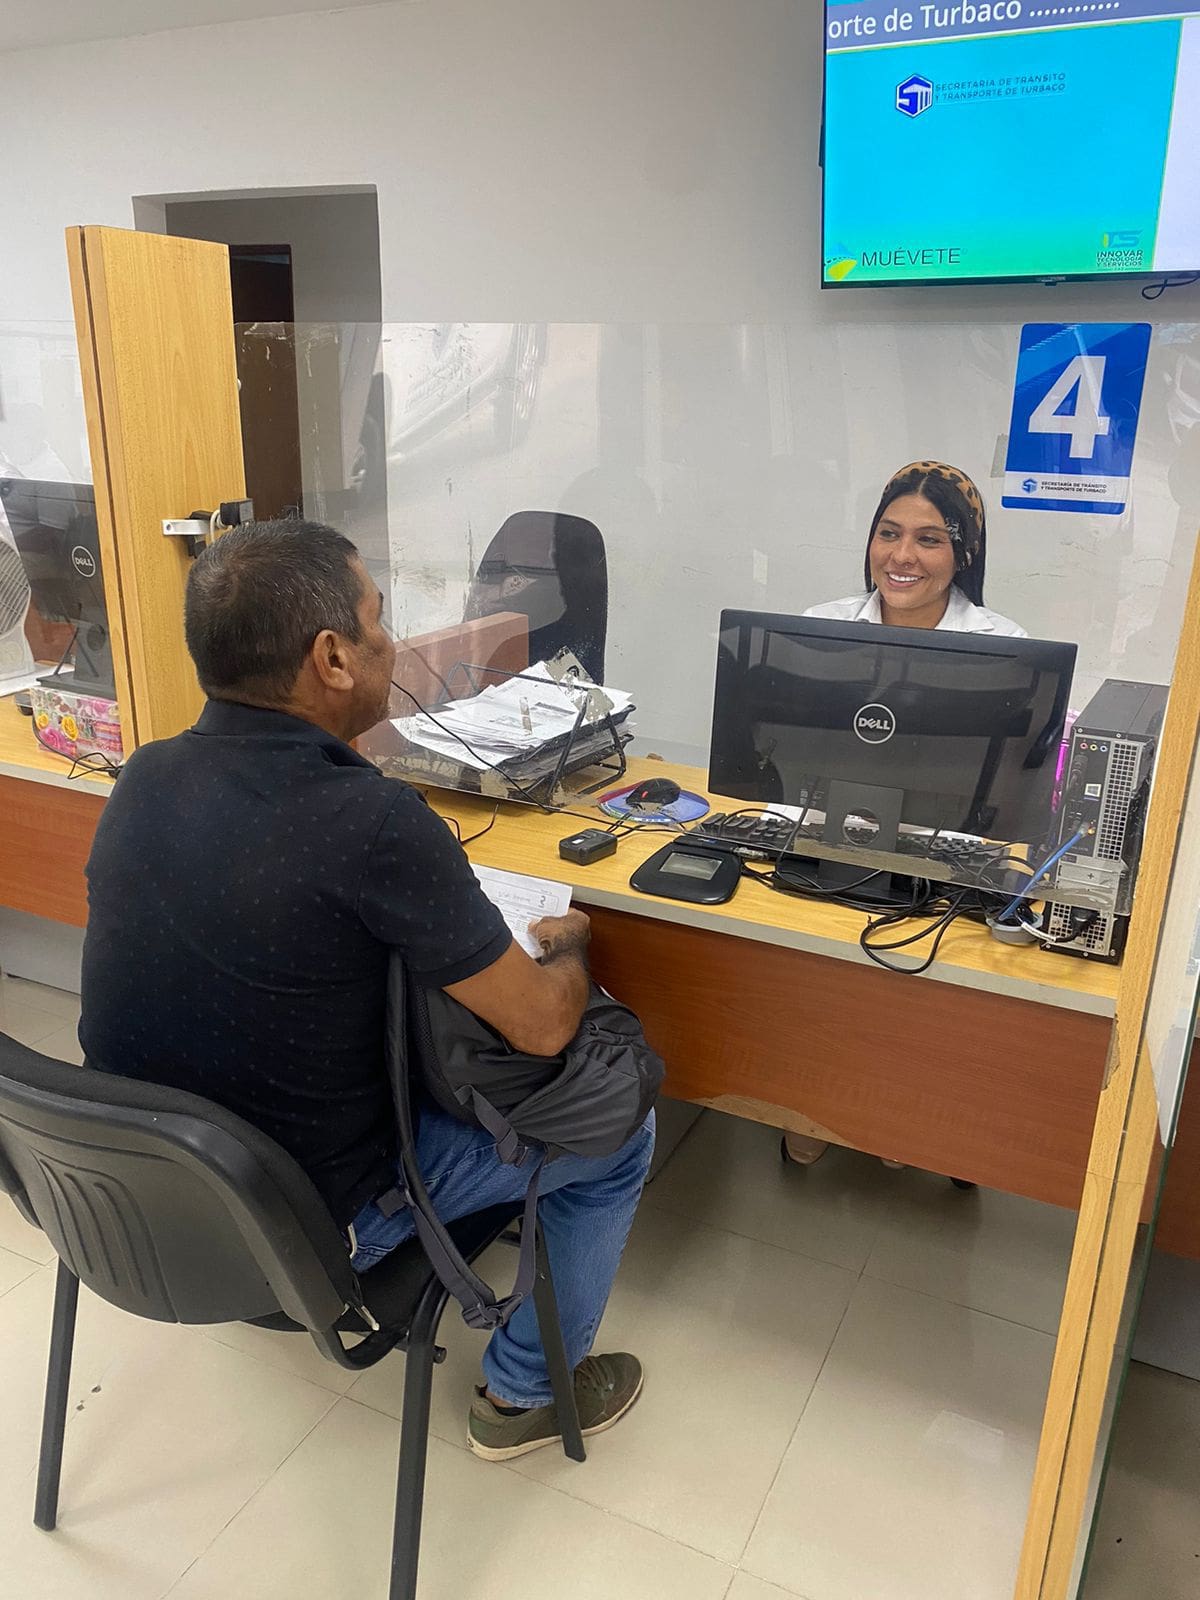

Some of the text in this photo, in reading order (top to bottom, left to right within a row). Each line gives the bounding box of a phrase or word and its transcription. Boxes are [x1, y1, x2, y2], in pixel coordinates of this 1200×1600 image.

[828, 17, 877, 39] orte
[884, 8, 913, 32] de
[919, 0, 1022, 29] Turbaco
[998, 77, 1012, 87] DE
[943, 89, 1003, 101] TRANSPORTE
[1005, 88, 1018, 96] DE
[1021, 83, 1066, 95] TURBACO
[861, 247, 961, 267] MUÉVETE
[1096, 250, 1144, 258] INNOVAR
[1028, 355, 1111, 459] 4
[74, 557, 93, 567] DELL
[858, 717, 891, 730] DELL
